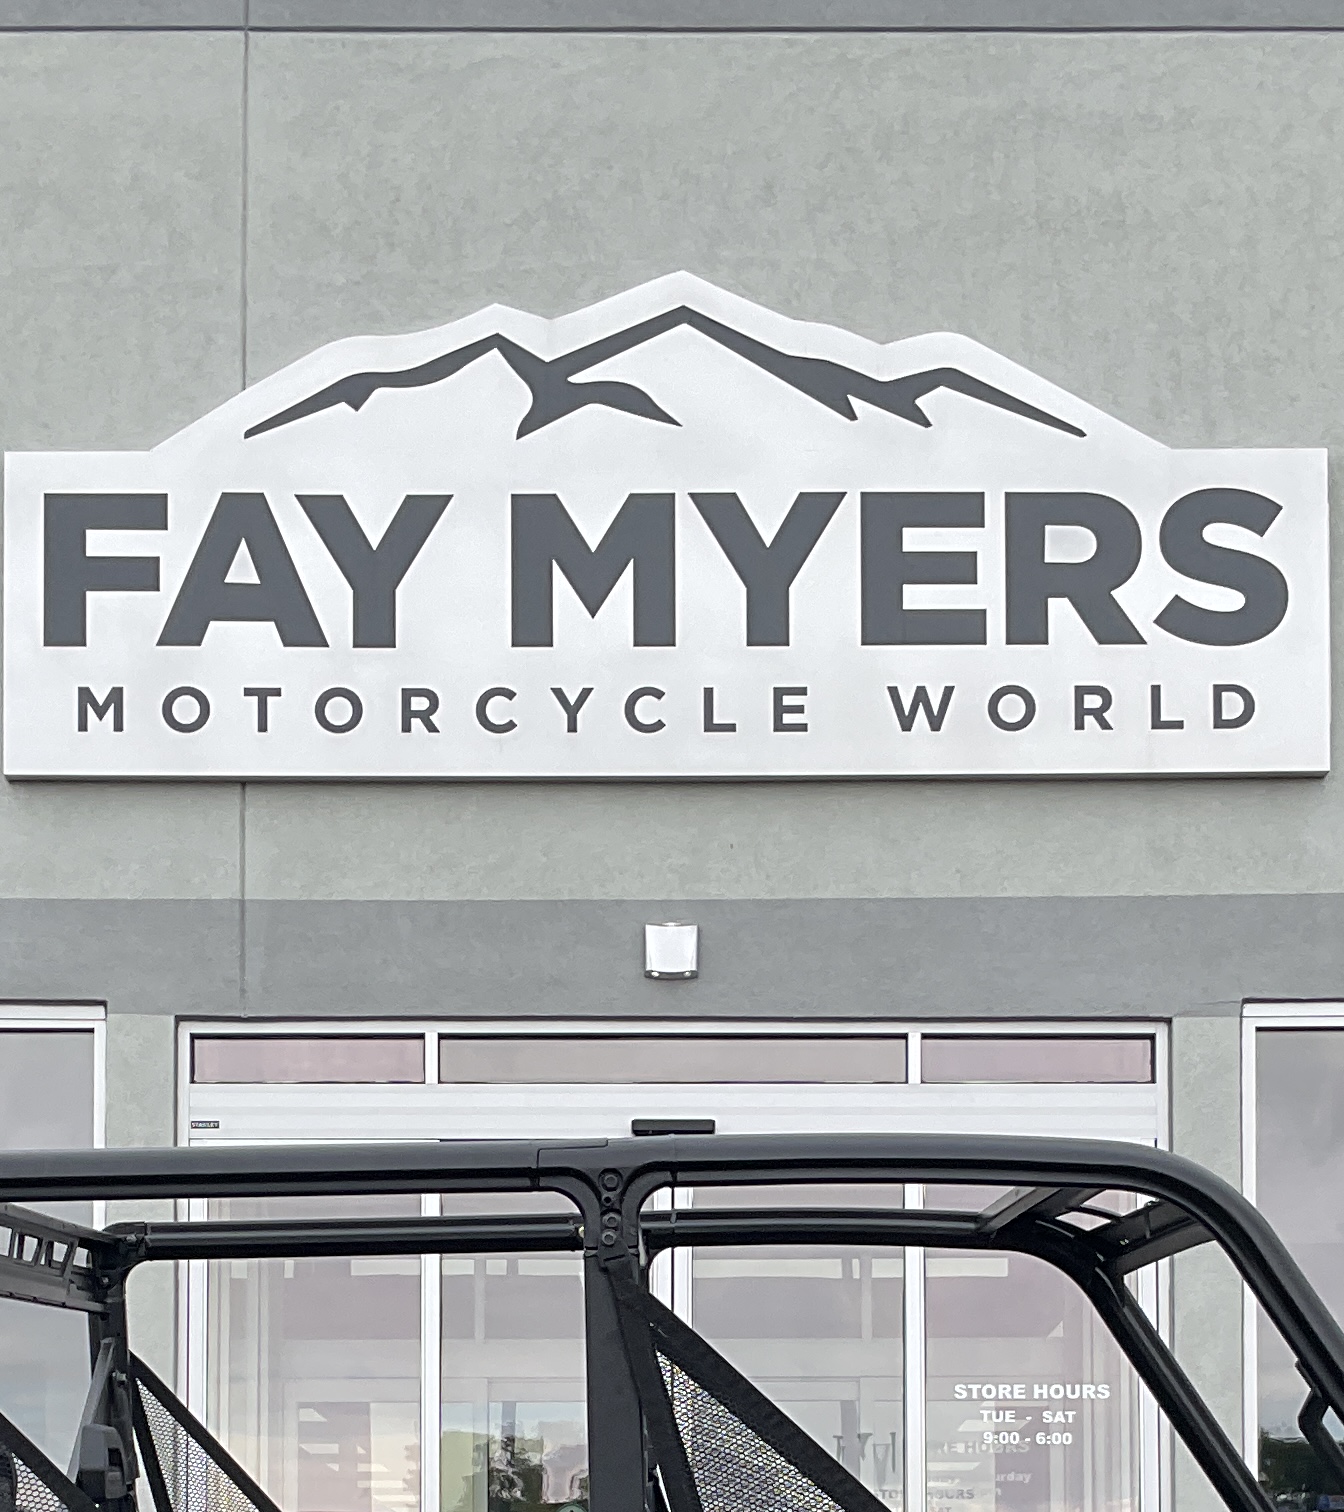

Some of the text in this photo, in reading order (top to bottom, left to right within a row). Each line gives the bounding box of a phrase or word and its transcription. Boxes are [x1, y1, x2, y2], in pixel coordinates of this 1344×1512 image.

[43, 487, 1289, 649] FAY MYERS
[77, 683, 1256, 734] MOTORCYCLE WORLD
[954, 1384, 1111, 1400] STORE HOURS
[980, 1410, 1016, 1423] TUE
[1042, 1410, 1077, 1423] SAT
[983, 1431, 1020, 1444] 9:00
[1035, 1431, 1073, 1445] 6:00
